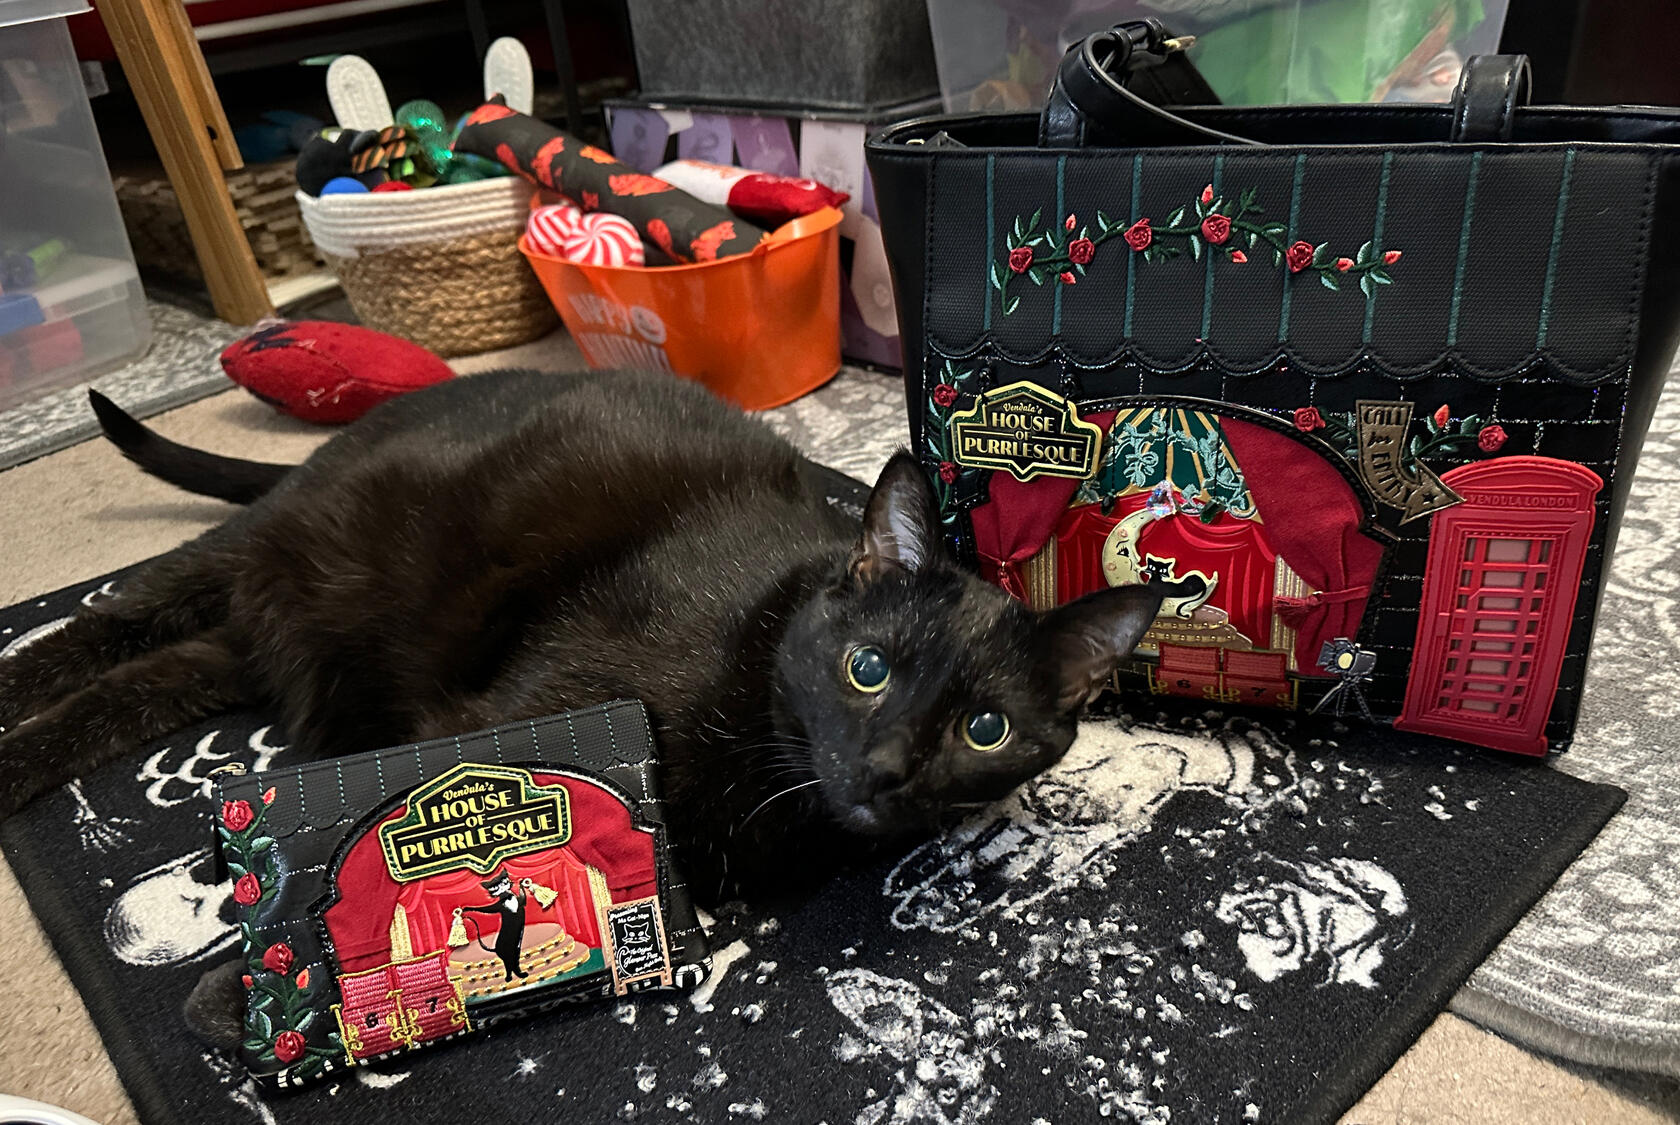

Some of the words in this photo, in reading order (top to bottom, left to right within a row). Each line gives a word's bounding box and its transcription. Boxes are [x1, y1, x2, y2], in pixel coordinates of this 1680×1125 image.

[991, 412, 1055, 433] HOUSE
[1015, 430, 1031, 441] OF
[964, 437, 1082, 465] PURRLESQUE
[1469, 494, 1522, 507] VENDULA
[1525, 495, 1574, 507] LONDON
[1176, 679, 1191, 689] 6
[1251, 687, 1267, 697] 7
[442, 781, 495, 801] Vendula's
[431, 790, 514, 823] HOUSE
[465, 814, 486, 828] OF
[401, 812, 555, 863] PURRLESQUE
[365, 1012, 379, 1028] 6
[425, 997, 439, 1014] 7
